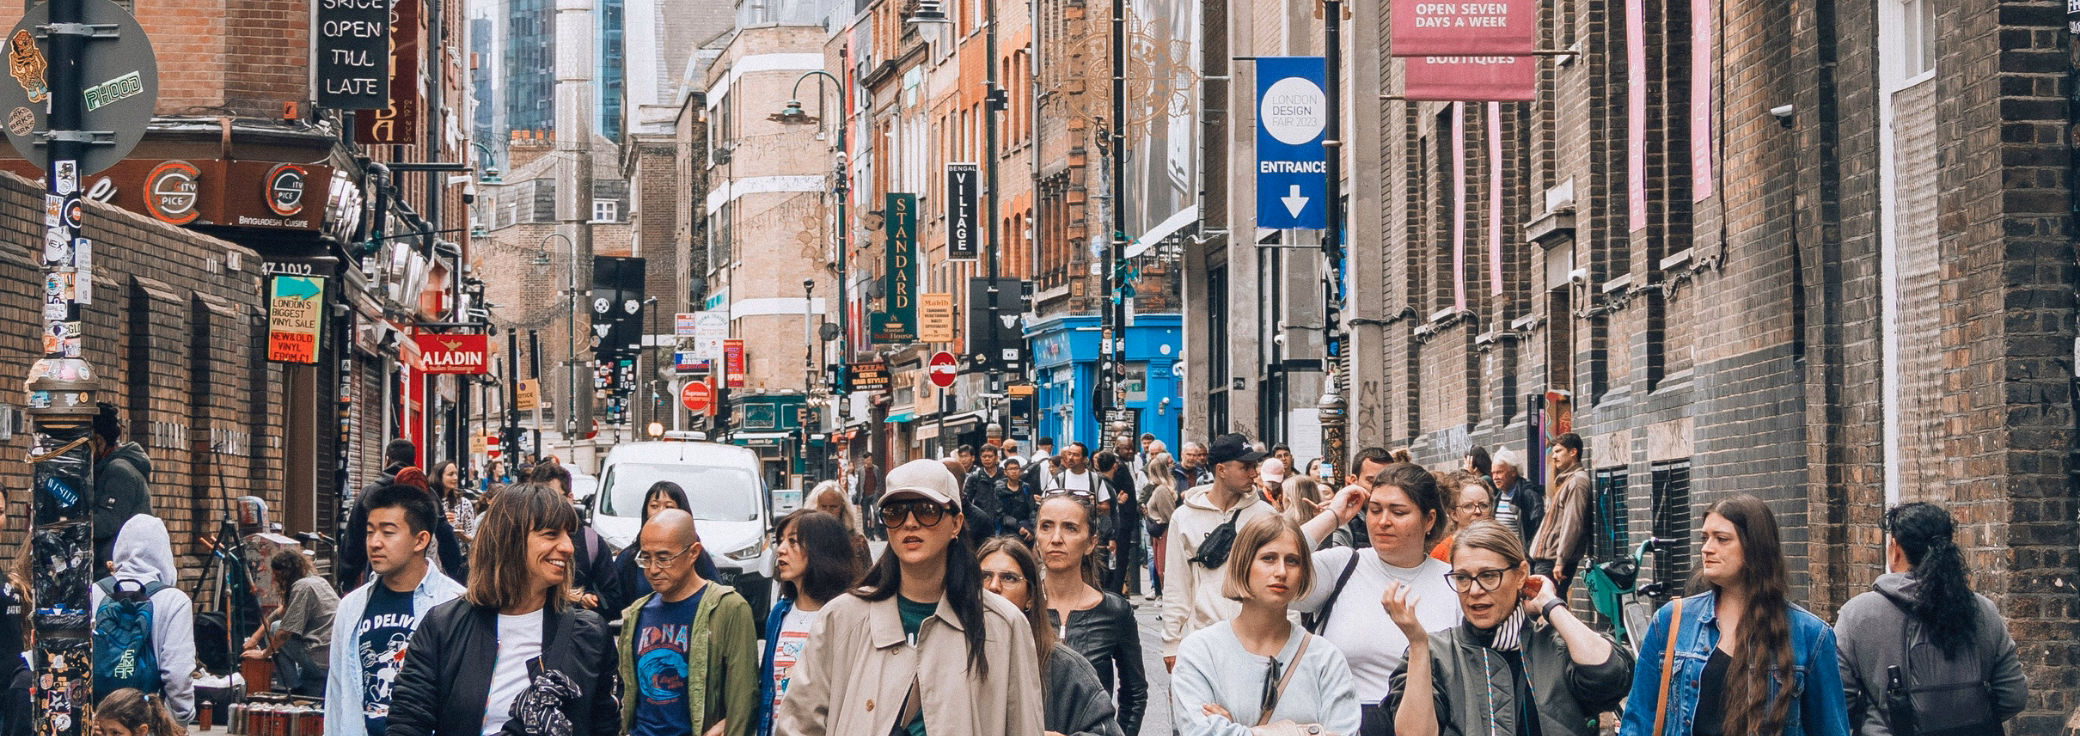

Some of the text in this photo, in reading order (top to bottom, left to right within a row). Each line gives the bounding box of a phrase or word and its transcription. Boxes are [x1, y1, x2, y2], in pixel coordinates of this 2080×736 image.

[1415, 3, 1507, 15] OPEN SEVEN
[1415, 16, 1507, 28] DAYS A WEEK
[324, 20, 381, 38] OPEN
[331, 49, 375, 67] TILL
[326, 78, 378, 95] LATE
[1271, 94, 1318, 105] LONDON
[1272, 105, 1312, 116] DESIGN
[1272, 117, 1318, 127] FAIR 2023
[1260, 160, 1327, 173] ENTRANCE
[956, 172, 968, 251] VILLAGE
[895, 198, 908, 309] STANDARD
[272, 308, 305, 319] BIGGEST
[272, 317, 315, 328] VINYL SALE
[278, 342, 302, 352] VINYL
[421, 351, 483, 366] ALADIN
